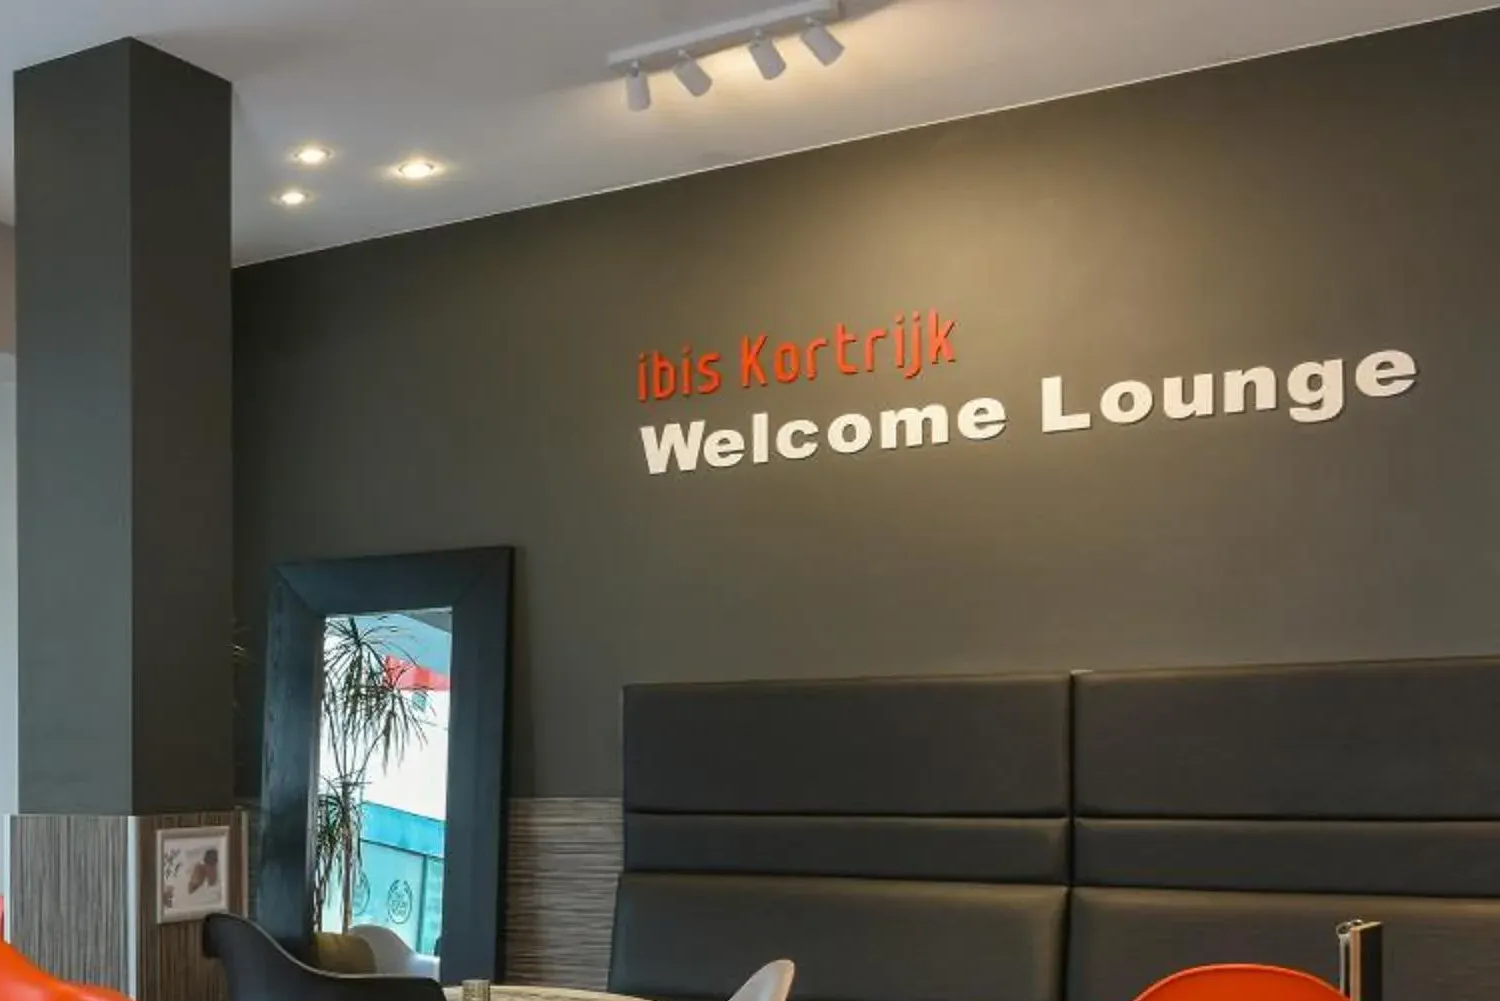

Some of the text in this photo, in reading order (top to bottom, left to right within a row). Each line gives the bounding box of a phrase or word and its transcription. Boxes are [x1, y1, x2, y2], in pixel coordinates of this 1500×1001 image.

[638, 308, 956, 402] ibis Kortrijk
[640, 349, 1417, 475] Welcome Lounge
